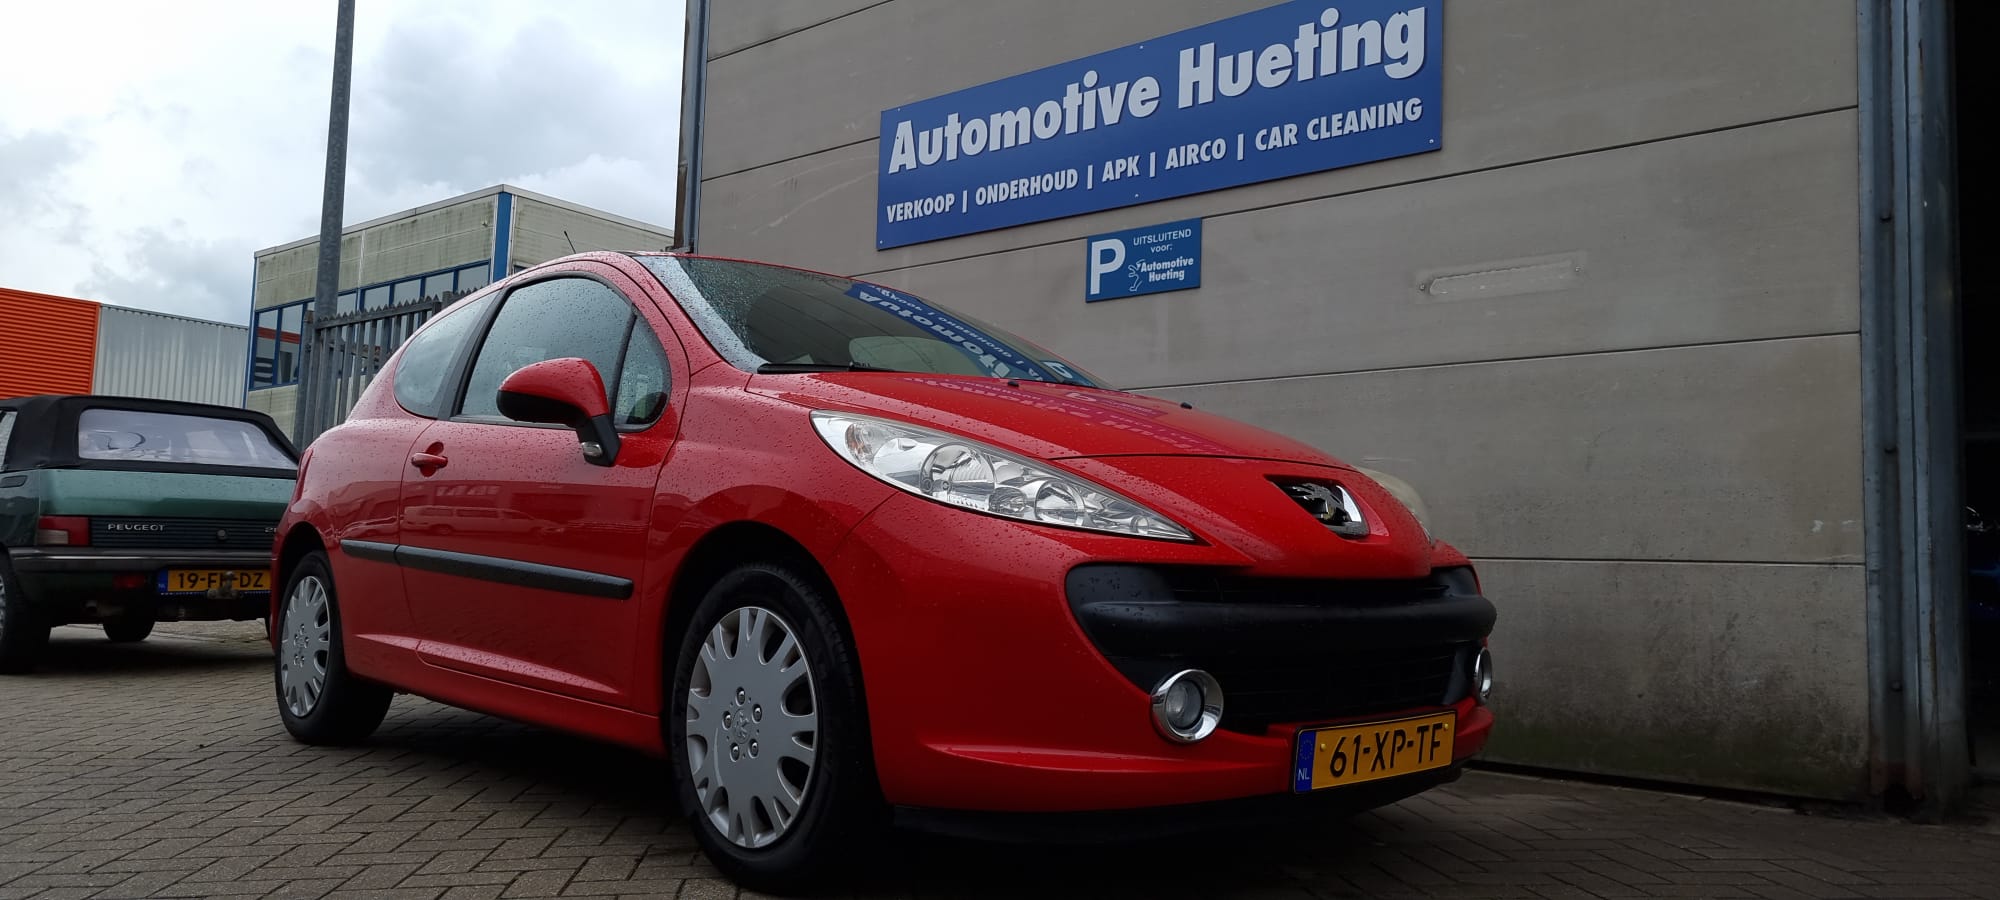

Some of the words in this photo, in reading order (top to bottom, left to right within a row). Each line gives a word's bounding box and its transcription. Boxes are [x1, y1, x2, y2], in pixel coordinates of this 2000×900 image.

[888, 70, 1160, 174] Automotive
[1178, 6, 1425, 109] Hueting
[886, 193, 955, 223] VERKOOP
[975, 168, 1078, 206] ONDERHOUD
[1102, 154, 1141, 182] APK
[1165, 138, 1226, 170] AIRCO
[1255, 123, 1297, 151] CAR
[1306, 97, 1423, 141] CLEANING
[1133, 229, 1192, 245] UITSLUITEND
[1151, 243, 1173, 253] voor:
[1090, 239, 1126, 295] P
[1141, 256, 1194, 272] Automotive
[1149, 269, 1185, 282] Hueting
[108, 523, 165, 531] PEUGEOT
[1297, 768, 1310, 781] NL
[1329, 722, 1443, 778] 61-XP-TF
